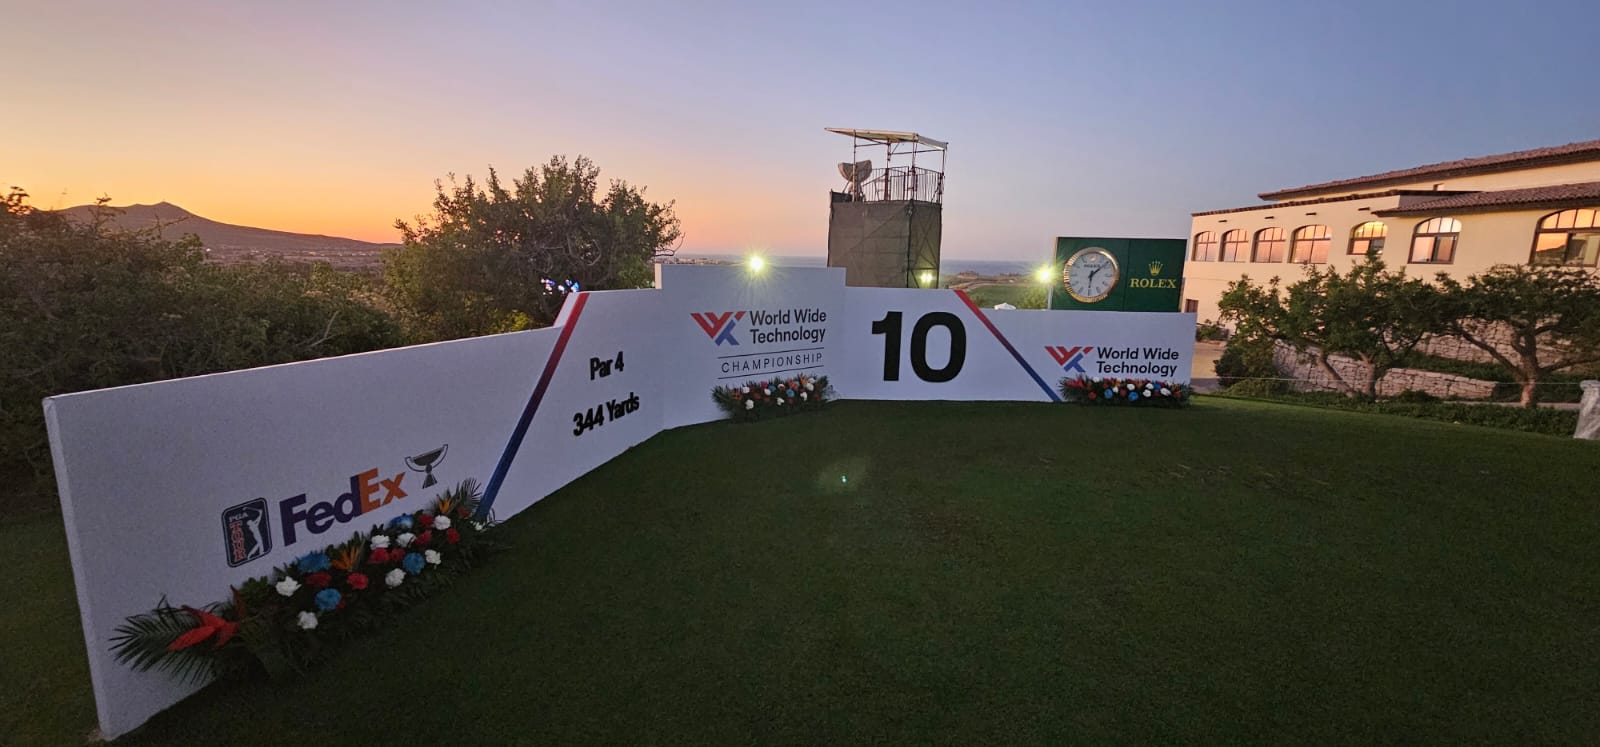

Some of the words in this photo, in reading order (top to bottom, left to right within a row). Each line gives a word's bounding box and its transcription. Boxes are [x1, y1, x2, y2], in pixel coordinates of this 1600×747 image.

[1130, 278, 1177, 289] ROLEX
[750, 309, 790, 326] World
[795, 308, 827, 323] Wide
[750, 326, 826, 344] Technology
[871, 311, 966, 384] 10
[1097, 347, 1139, 360] World
[1142, 347, 1179, 360] Wide
[589, 357, 613, 381] Par
[614, 351, 625, 372] 4
[721, 352, 823, 373] CHAMPIONSHIP
[1096, 361, 1178, 377] Technology
[573, 404, 605, 436] 344
[606, 391, 640, 422] Yards
[279, 467, 408, 547] FedEx
[228, 512, 248, 522] PGA
[229, 520, 247, 562] TOUR
